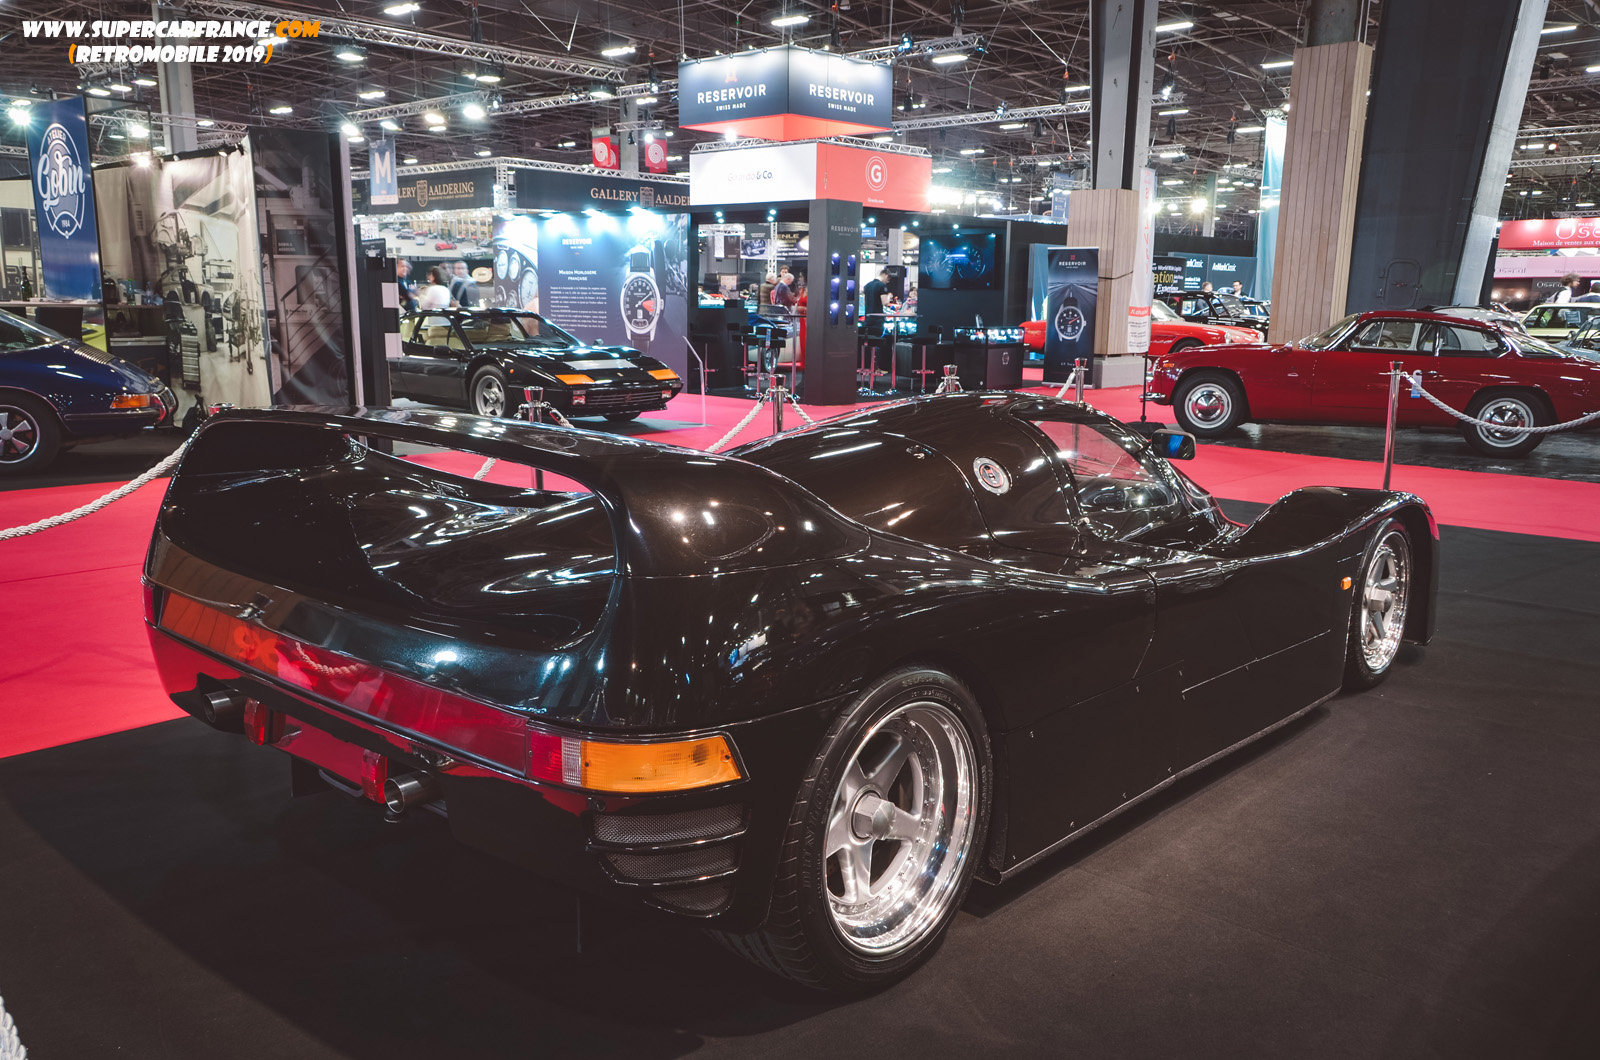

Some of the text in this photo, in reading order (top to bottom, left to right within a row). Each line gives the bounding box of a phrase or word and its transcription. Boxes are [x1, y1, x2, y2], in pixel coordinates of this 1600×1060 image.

[697, 83, 767, 104] RESERVOIR
[809, 83, 875, 106] RESERVOIR
[716, 102, 747, 112] SWISS MADE
[827, 102, 857, 113] SWISS MADE
[47, 129, 67, 145] ATELIER
[374, 151, 392, 184] M
[870, 164, 882, 183] G
[398, 187, 417, 199] LERY
[428, 181, 474, 196] AALDERING
[590, 187, 690, 206] GALLERY AALDE
[830, 225, 859, 233] RESERVOIR
[1555, 219, 1600, 240] Ose
[562, 238, 593, 246] RESERVOIR
[1154, 271, 1174, 283] ation
